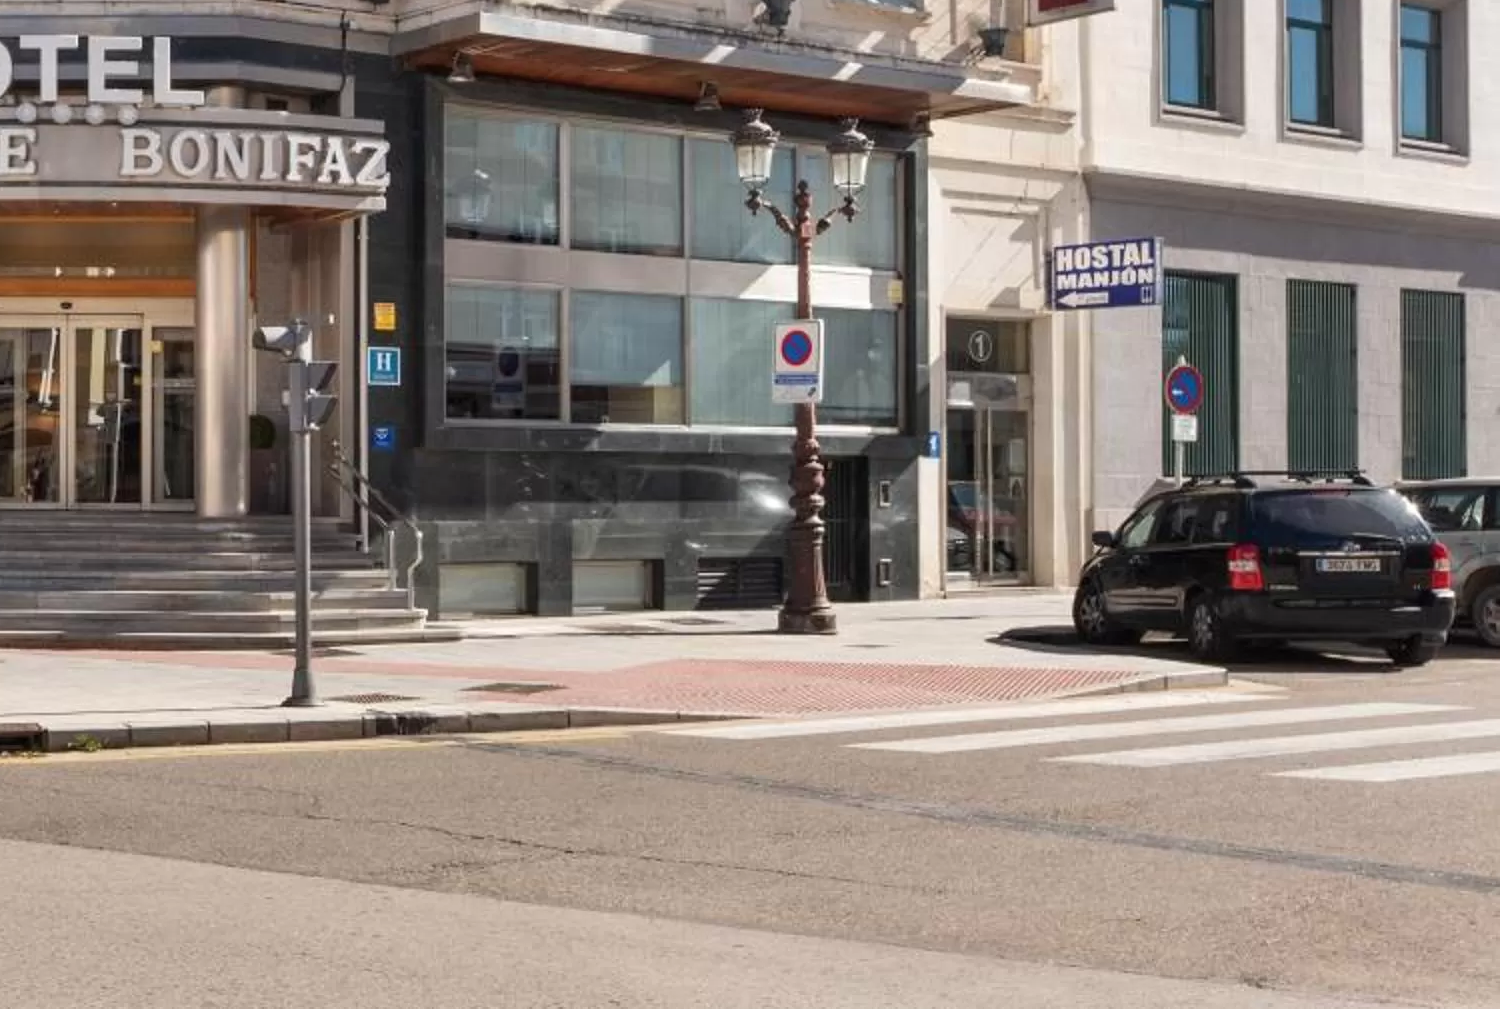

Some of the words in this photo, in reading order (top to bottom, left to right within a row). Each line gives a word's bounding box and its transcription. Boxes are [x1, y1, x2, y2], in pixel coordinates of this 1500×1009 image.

[119, 127, 392, 188] BONIFAZ
[1056, 241, 1154, 271] HOSTAL
[1057, 265, 1153, 290] MANJÓN
[376, 352, 392, 372] H
